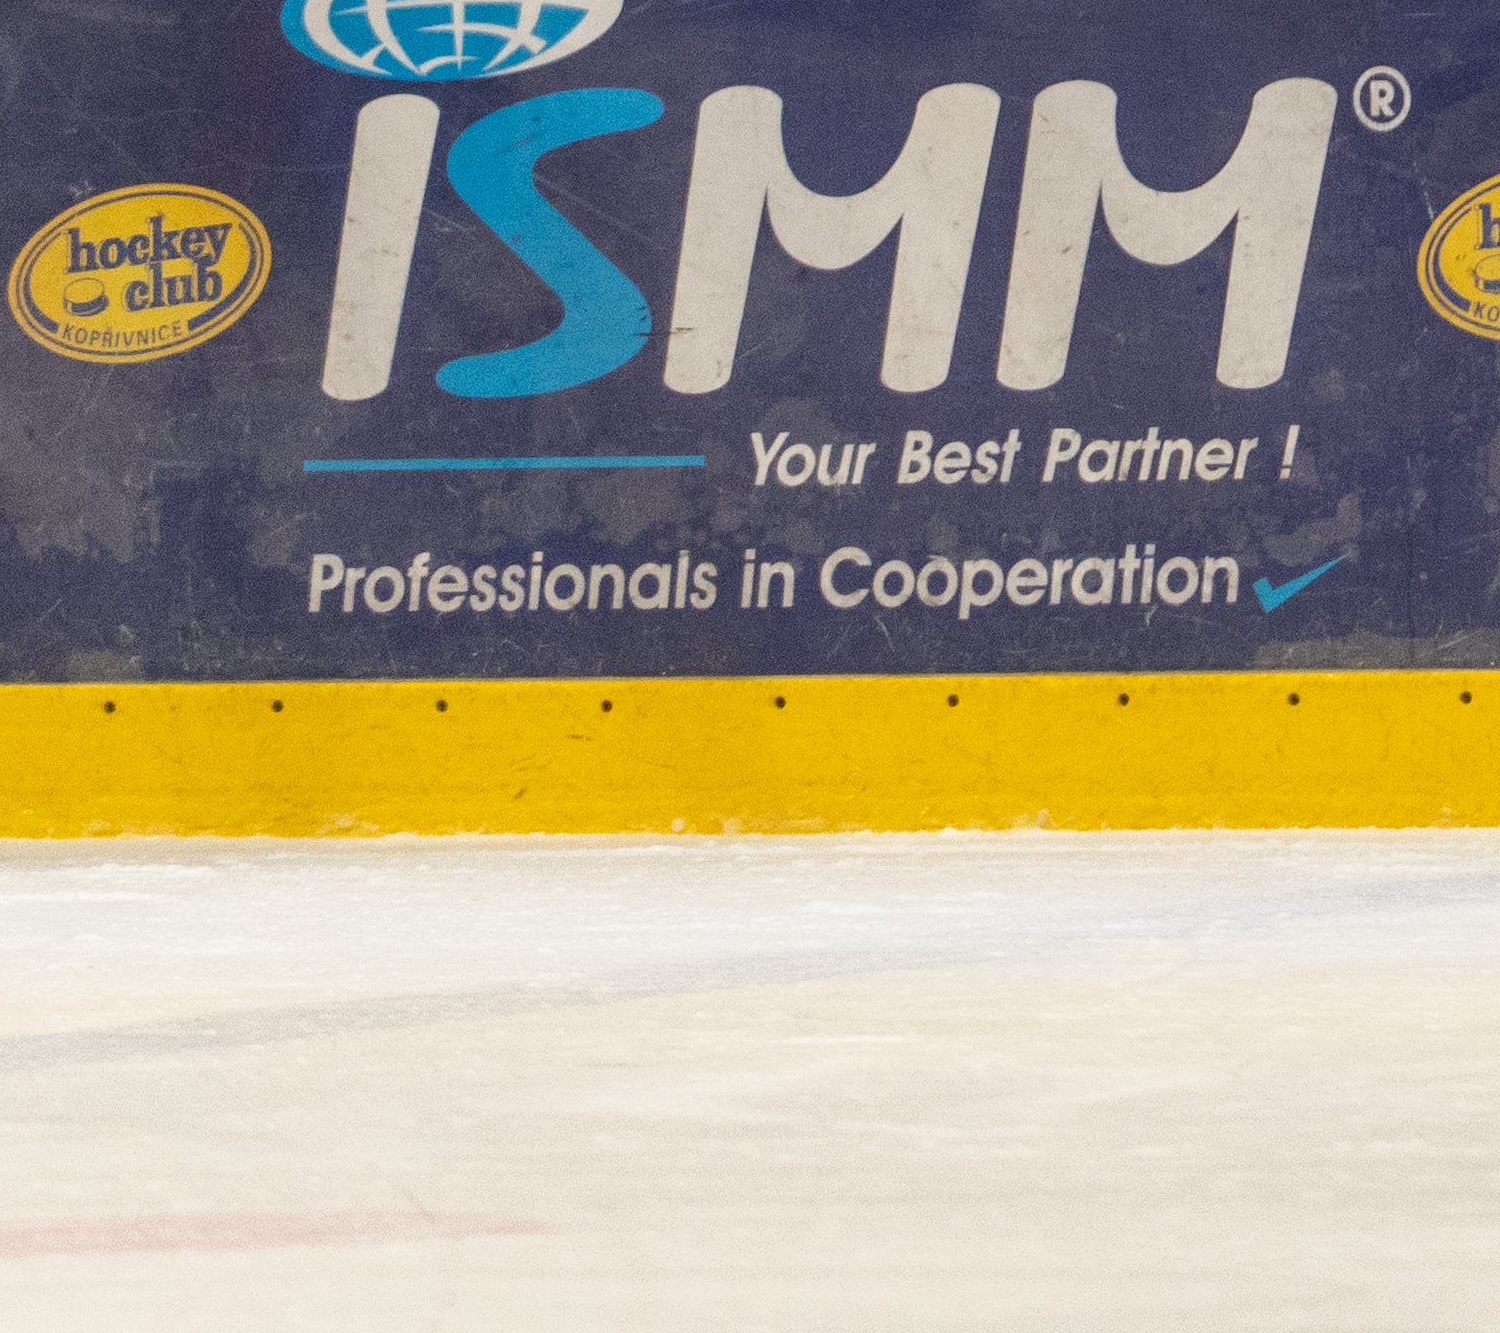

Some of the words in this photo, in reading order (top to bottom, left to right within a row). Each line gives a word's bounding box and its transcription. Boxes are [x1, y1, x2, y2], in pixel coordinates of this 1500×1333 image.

[66, 215, 232, 277] hockey
[124, 265, 223, 312] club
[60, 320, 184, 349] KOPŘIVNICE
[749, 432, 875, 488] Your
[899, 430, 1020, 484] Best
[1041, 428, 1259, 482] Partner
[1279, 424, 1301, 479] !
[307, 549, 718, 614] Professionals
[742, 551, 794, 608] in
[820, 544, 1240, 618] Cooperation
